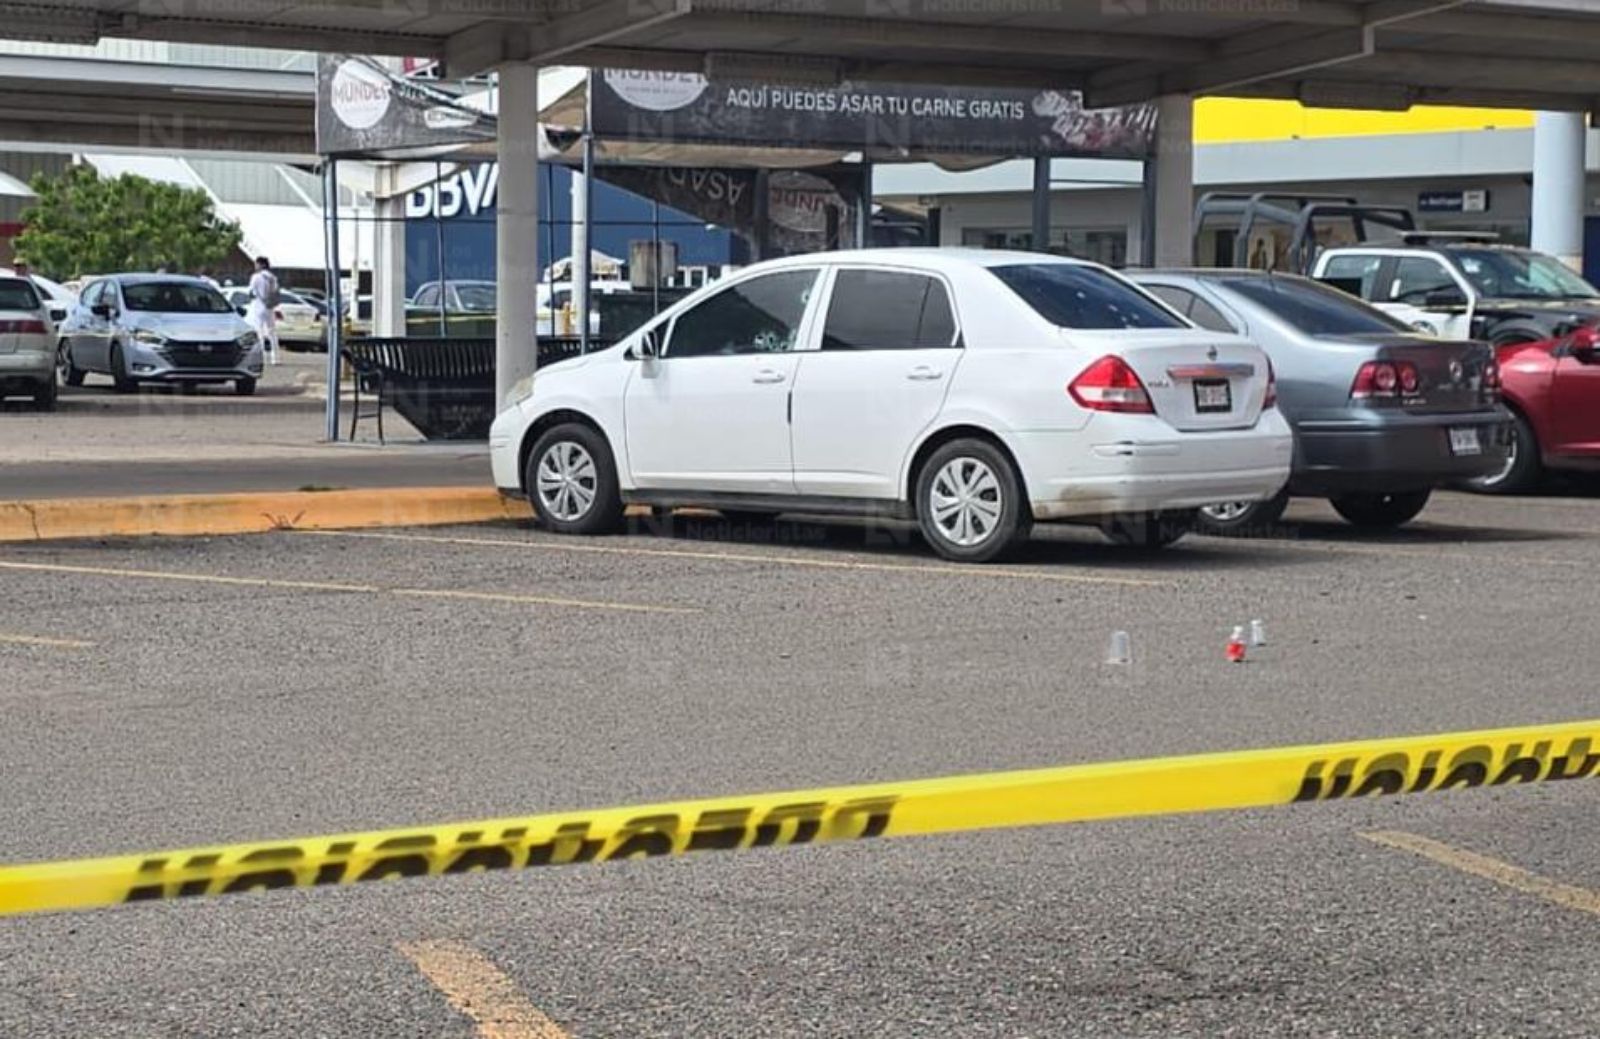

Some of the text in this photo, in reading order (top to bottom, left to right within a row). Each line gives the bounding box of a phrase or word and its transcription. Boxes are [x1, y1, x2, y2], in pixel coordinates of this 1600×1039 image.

[726, 85, 1025, 120] AQUÍ PUEDES ASAR TU CARNE GRATIS
